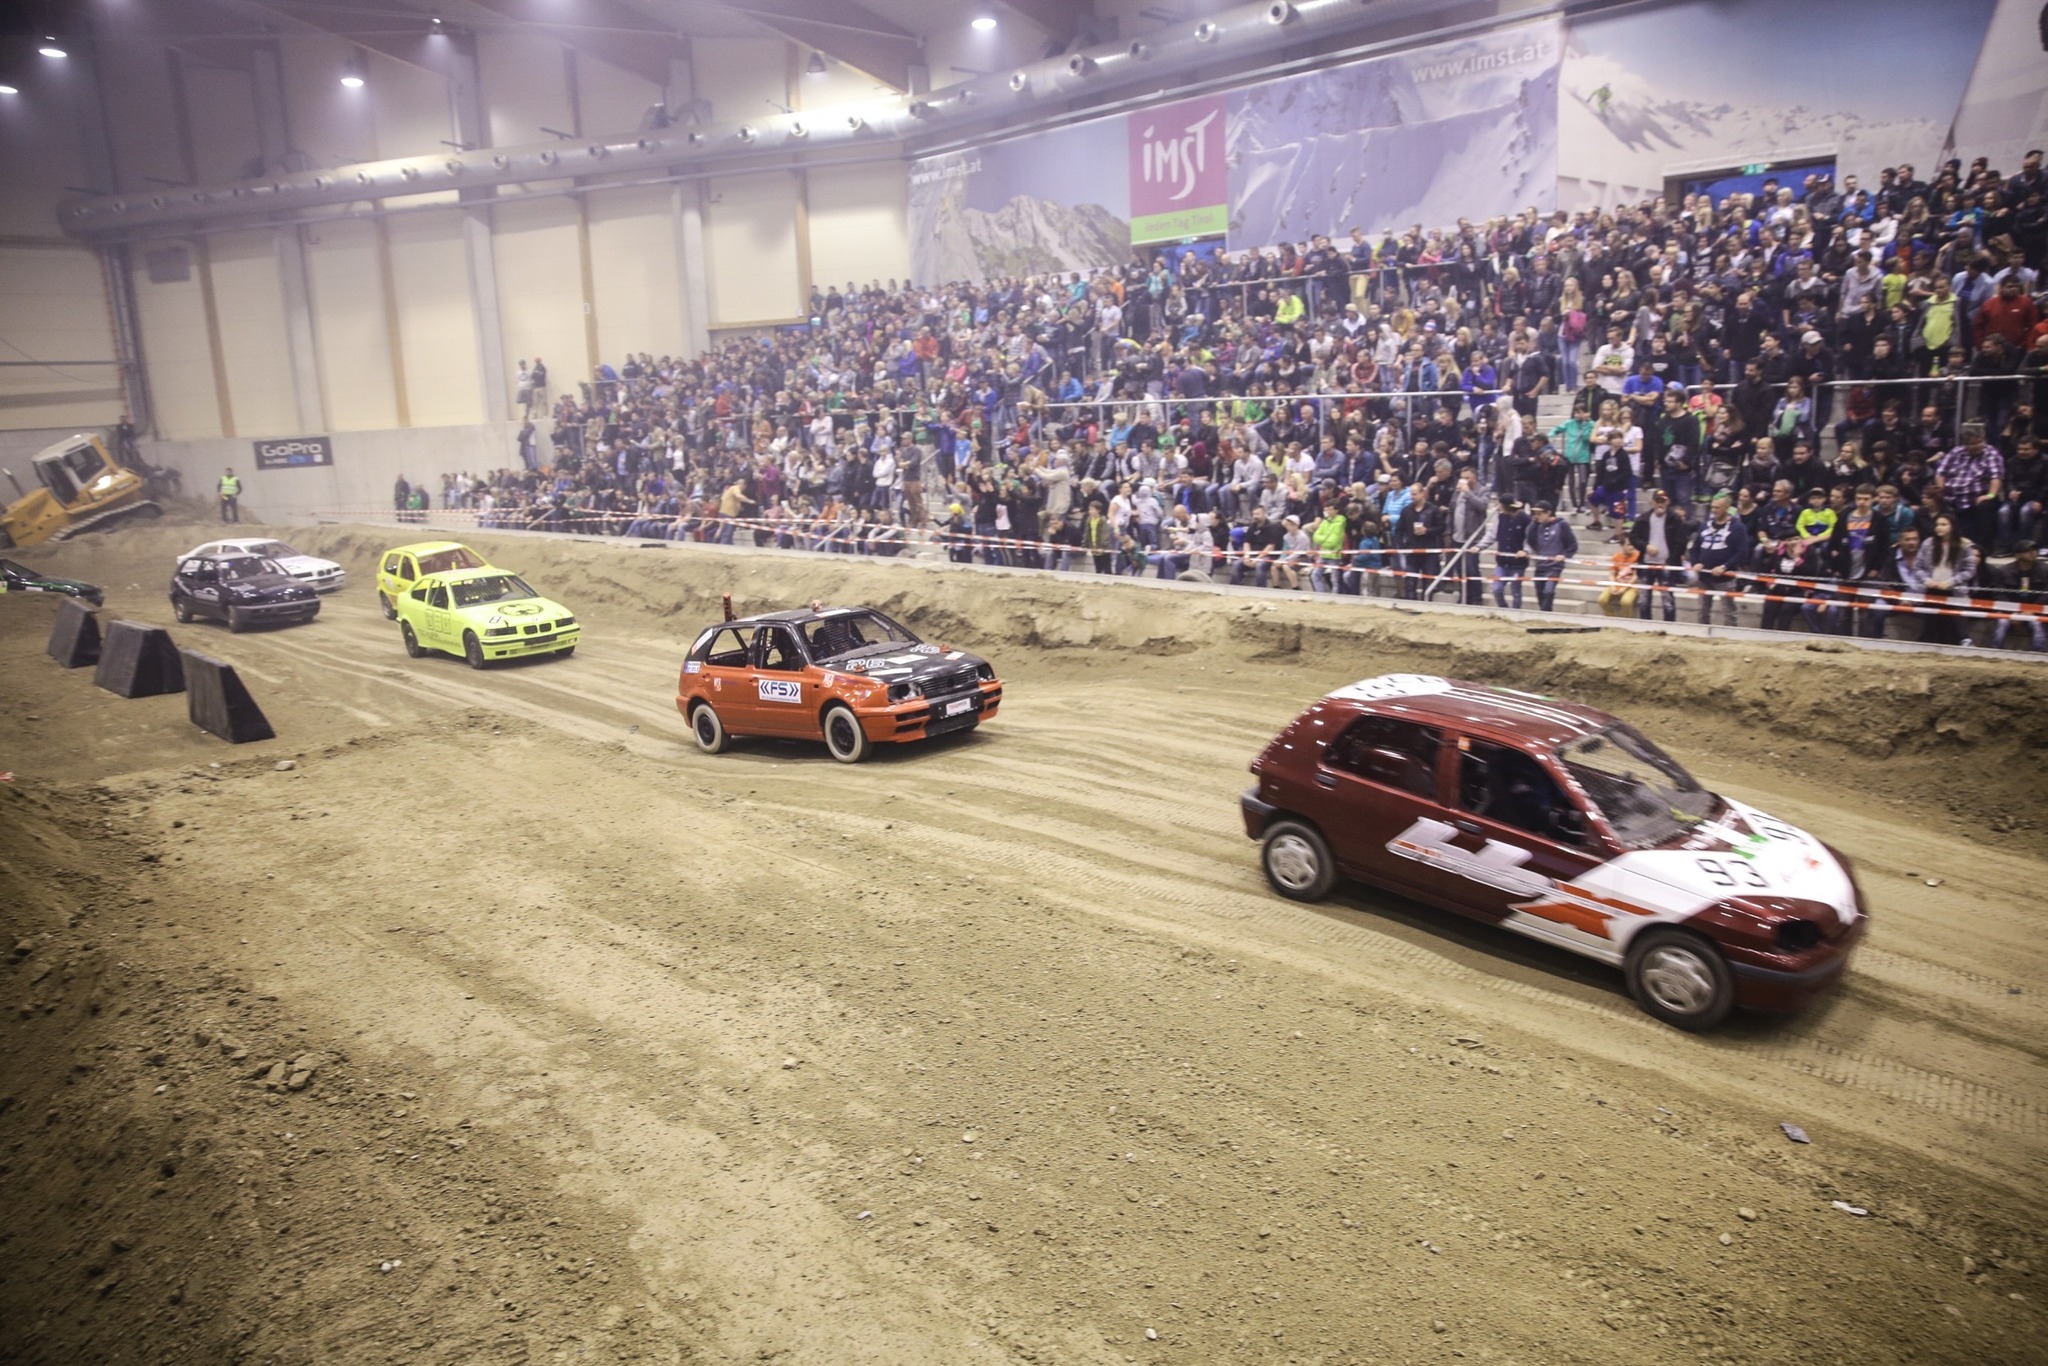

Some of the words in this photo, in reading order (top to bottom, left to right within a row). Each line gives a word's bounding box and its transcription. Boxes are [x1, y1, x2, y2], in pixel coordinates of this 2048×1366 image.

[1412, 41, 1545, 83] www.imst.at
[910, 157, 982, 185] www.imst.at
[261, 443, 322, 457] GoPro
[1696, 858, 1769, 887] 93
